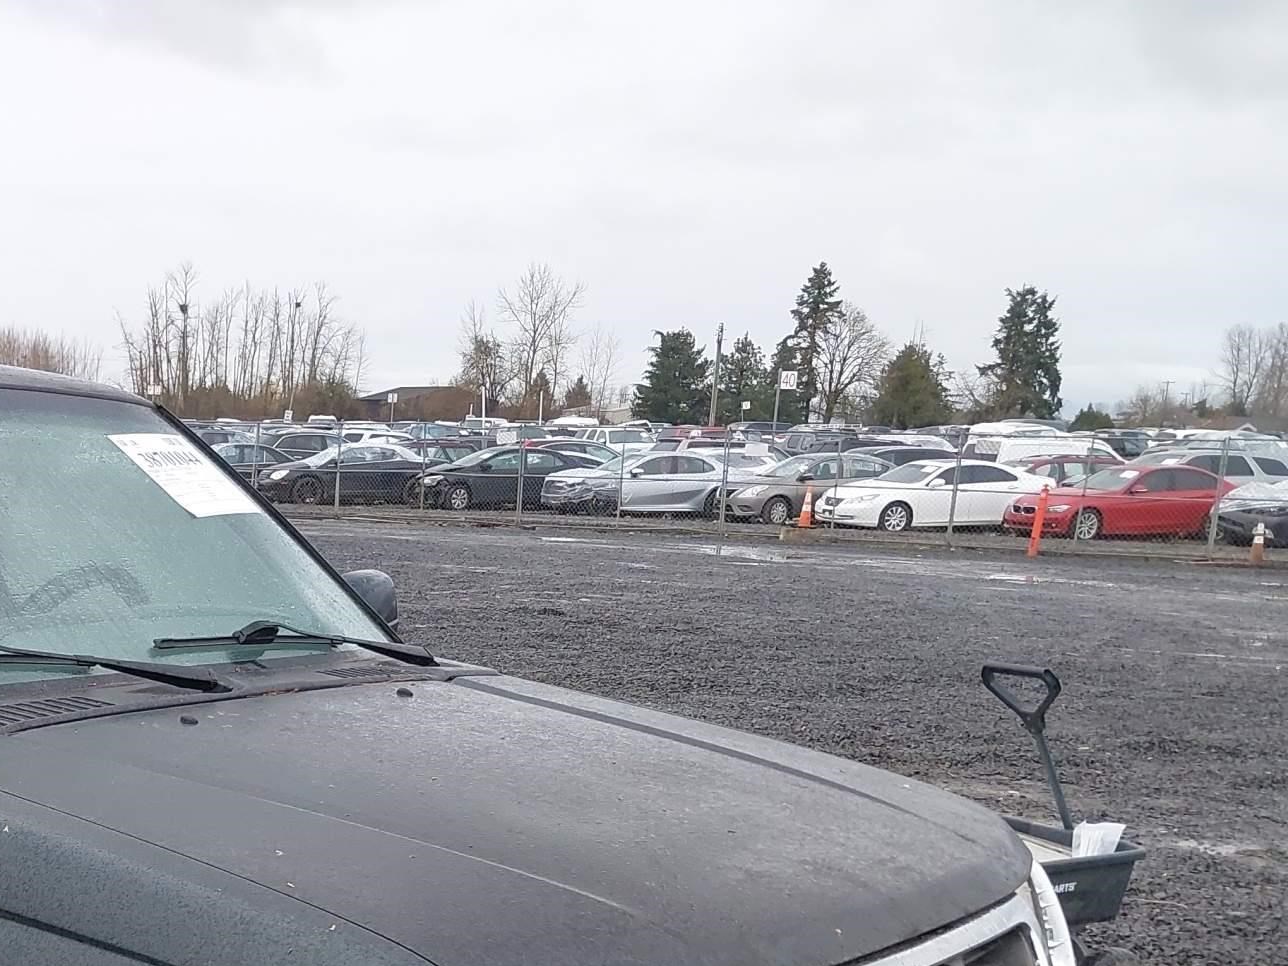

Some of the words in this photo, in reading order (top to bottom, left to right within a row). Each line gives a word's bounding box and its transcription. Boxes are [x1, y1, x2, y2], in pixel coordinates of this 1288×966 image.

[782, 373, 796, 388] 40
[137, 450, 203, 468] 38701044
[1054, 881, 1078, 894] ARTS
